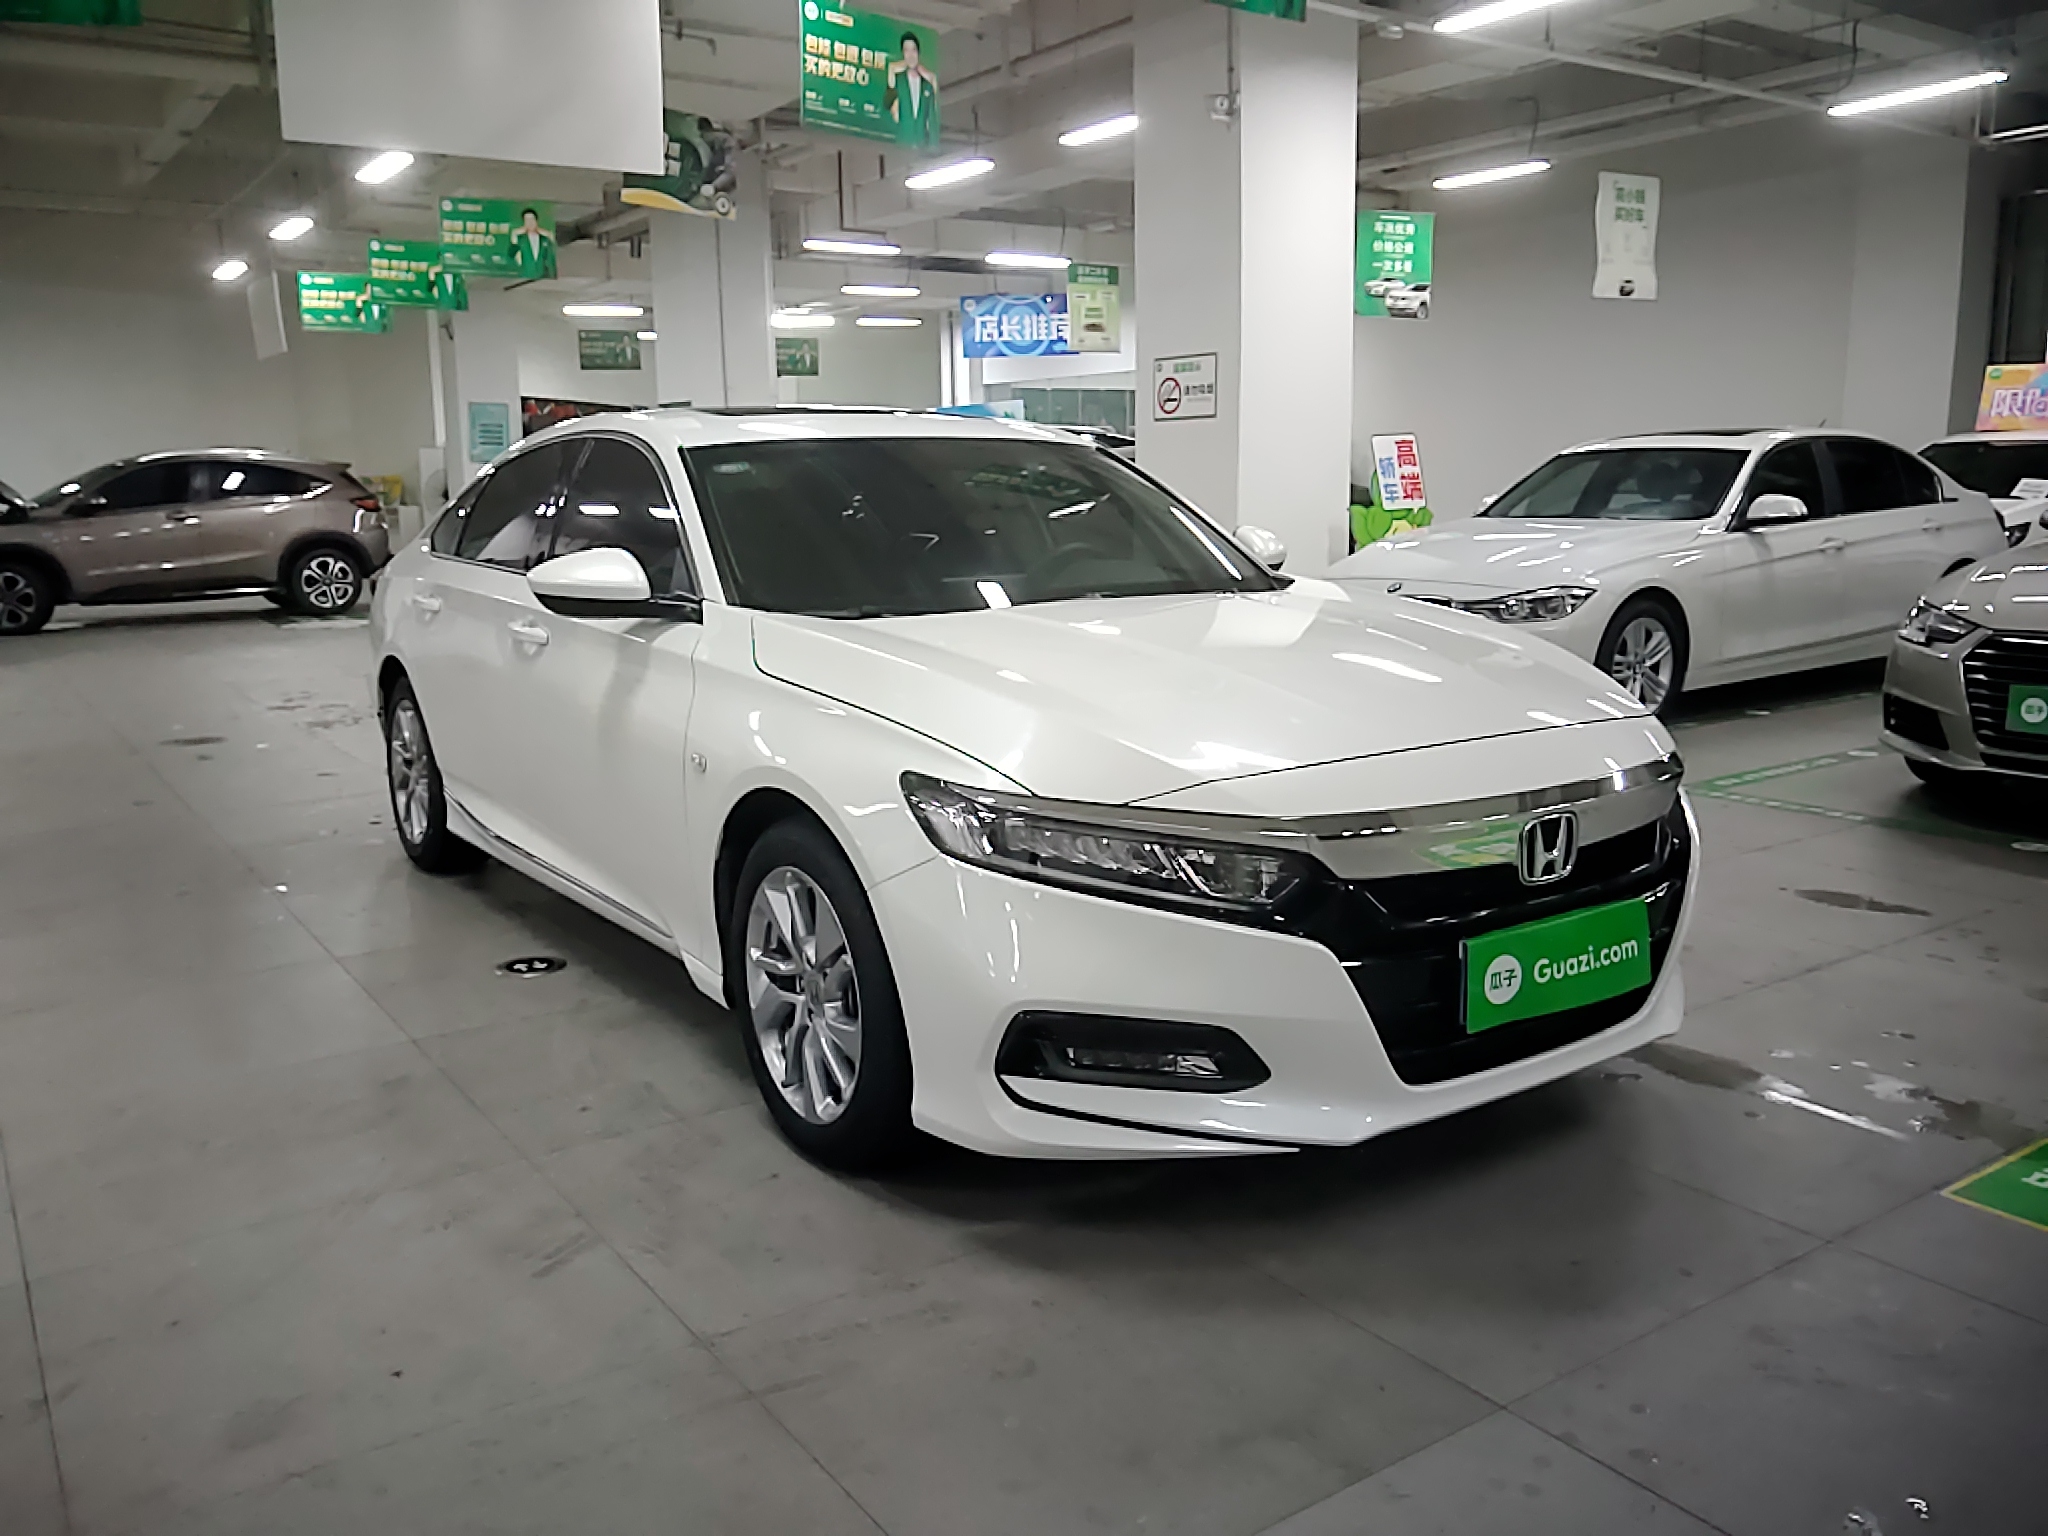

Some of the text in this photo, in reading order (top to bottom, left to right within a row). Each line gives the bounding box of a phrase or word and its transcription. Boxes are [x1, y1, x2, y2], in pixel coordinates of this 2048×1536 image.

[1395, 439, 1423, 500] 高端
[1489, 968, 1518, 991] 瓜子
[1533, 938, 1638, 984] Guazi.com
